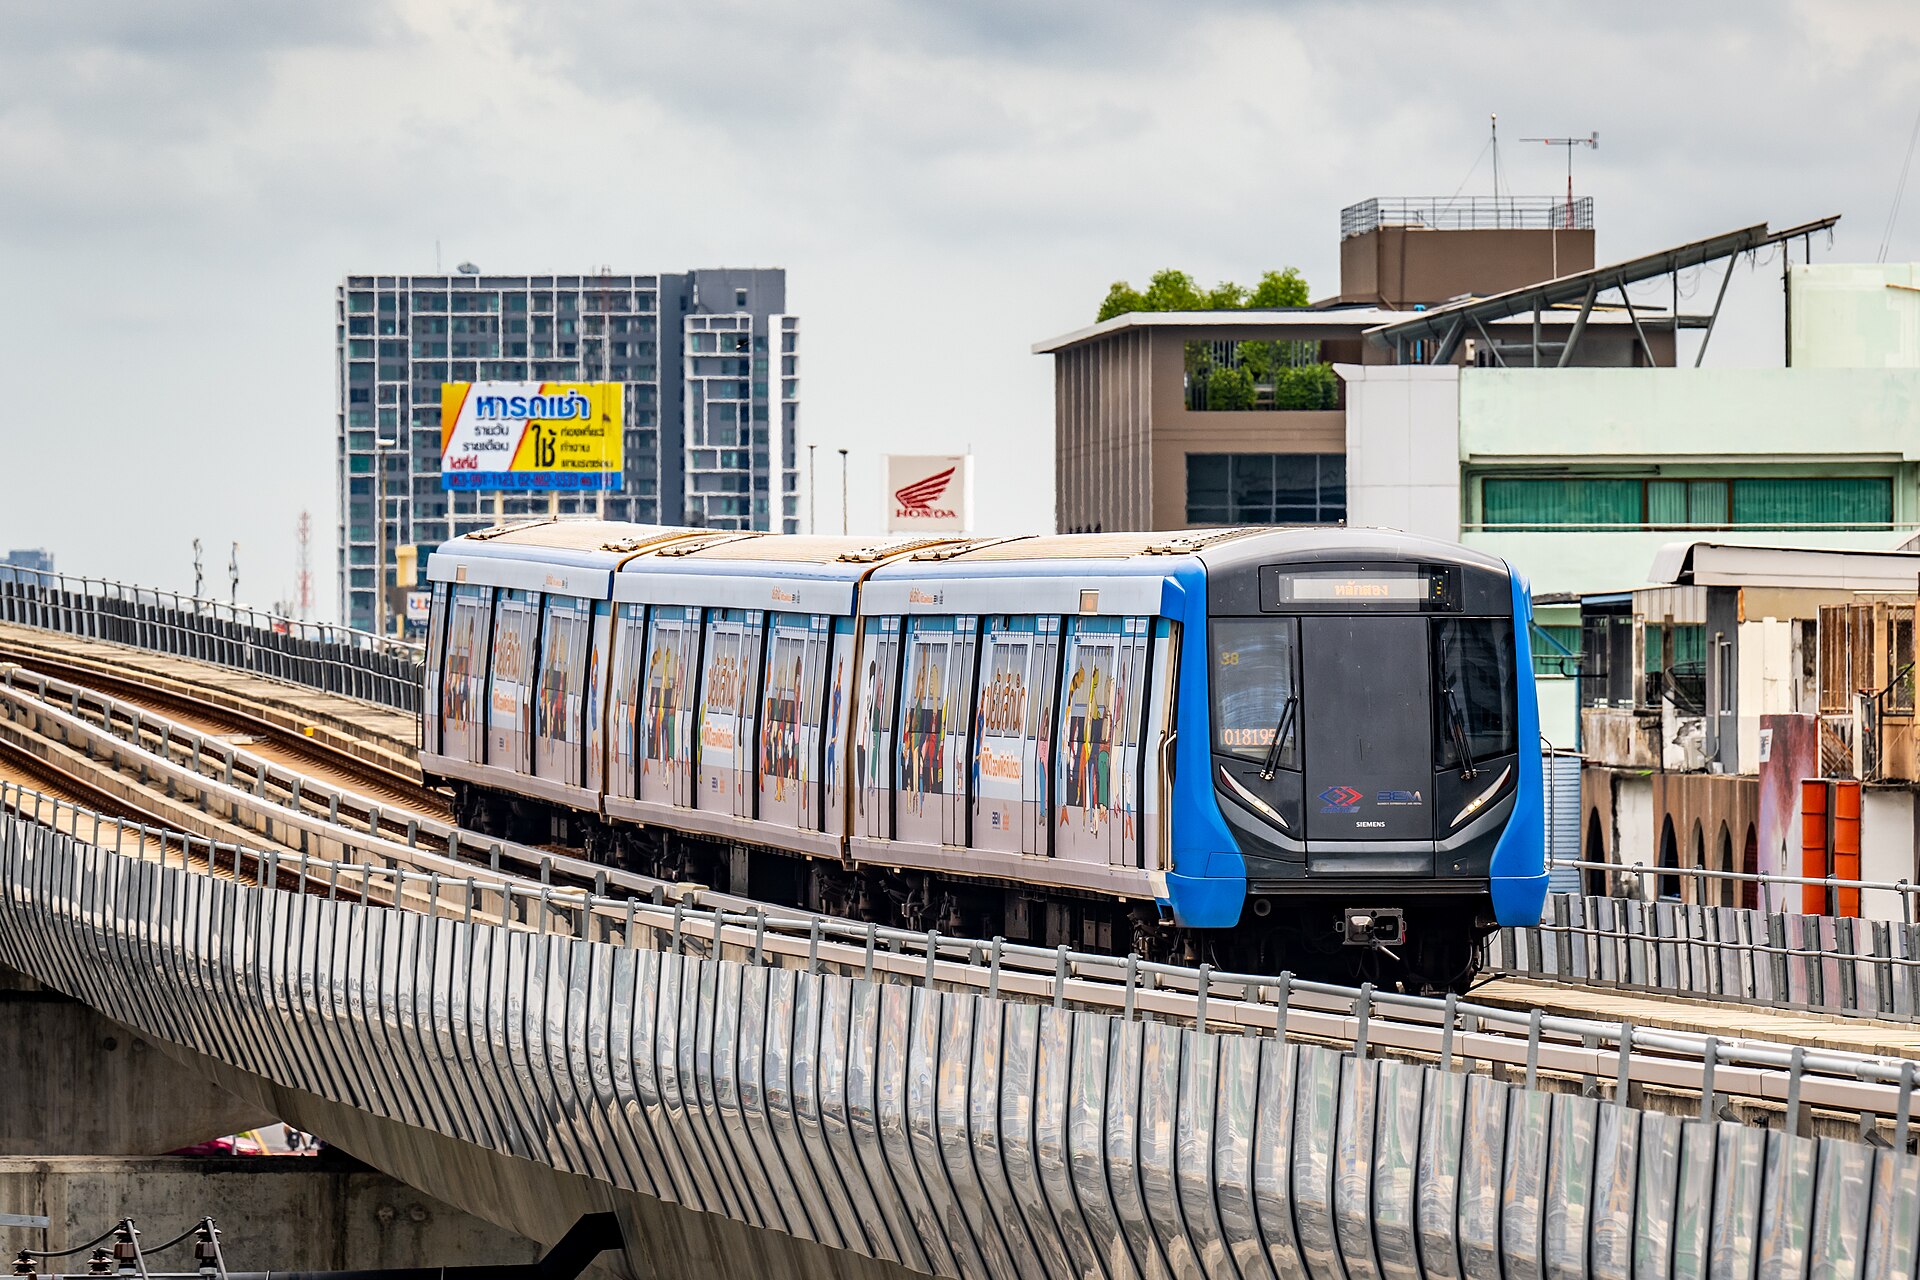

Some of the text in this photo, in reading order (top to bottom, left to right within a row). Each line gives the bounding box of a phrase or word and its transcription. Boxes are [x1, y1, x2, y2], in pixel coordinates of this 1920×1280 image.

[476, 391, 590, 418] หารถเช่า
[475, 423, 509, 435] รายวัน
[463, 439, 509, 451] รายเดือน
[532, 424, 557, 467] ใช้
[896, 509, 957, 518] HONDA
[1334, 580, 1389, 596] หลักสอง
[1220, 652, 1239, 665] 38
[1376, 790, 1422, 802] BEM
